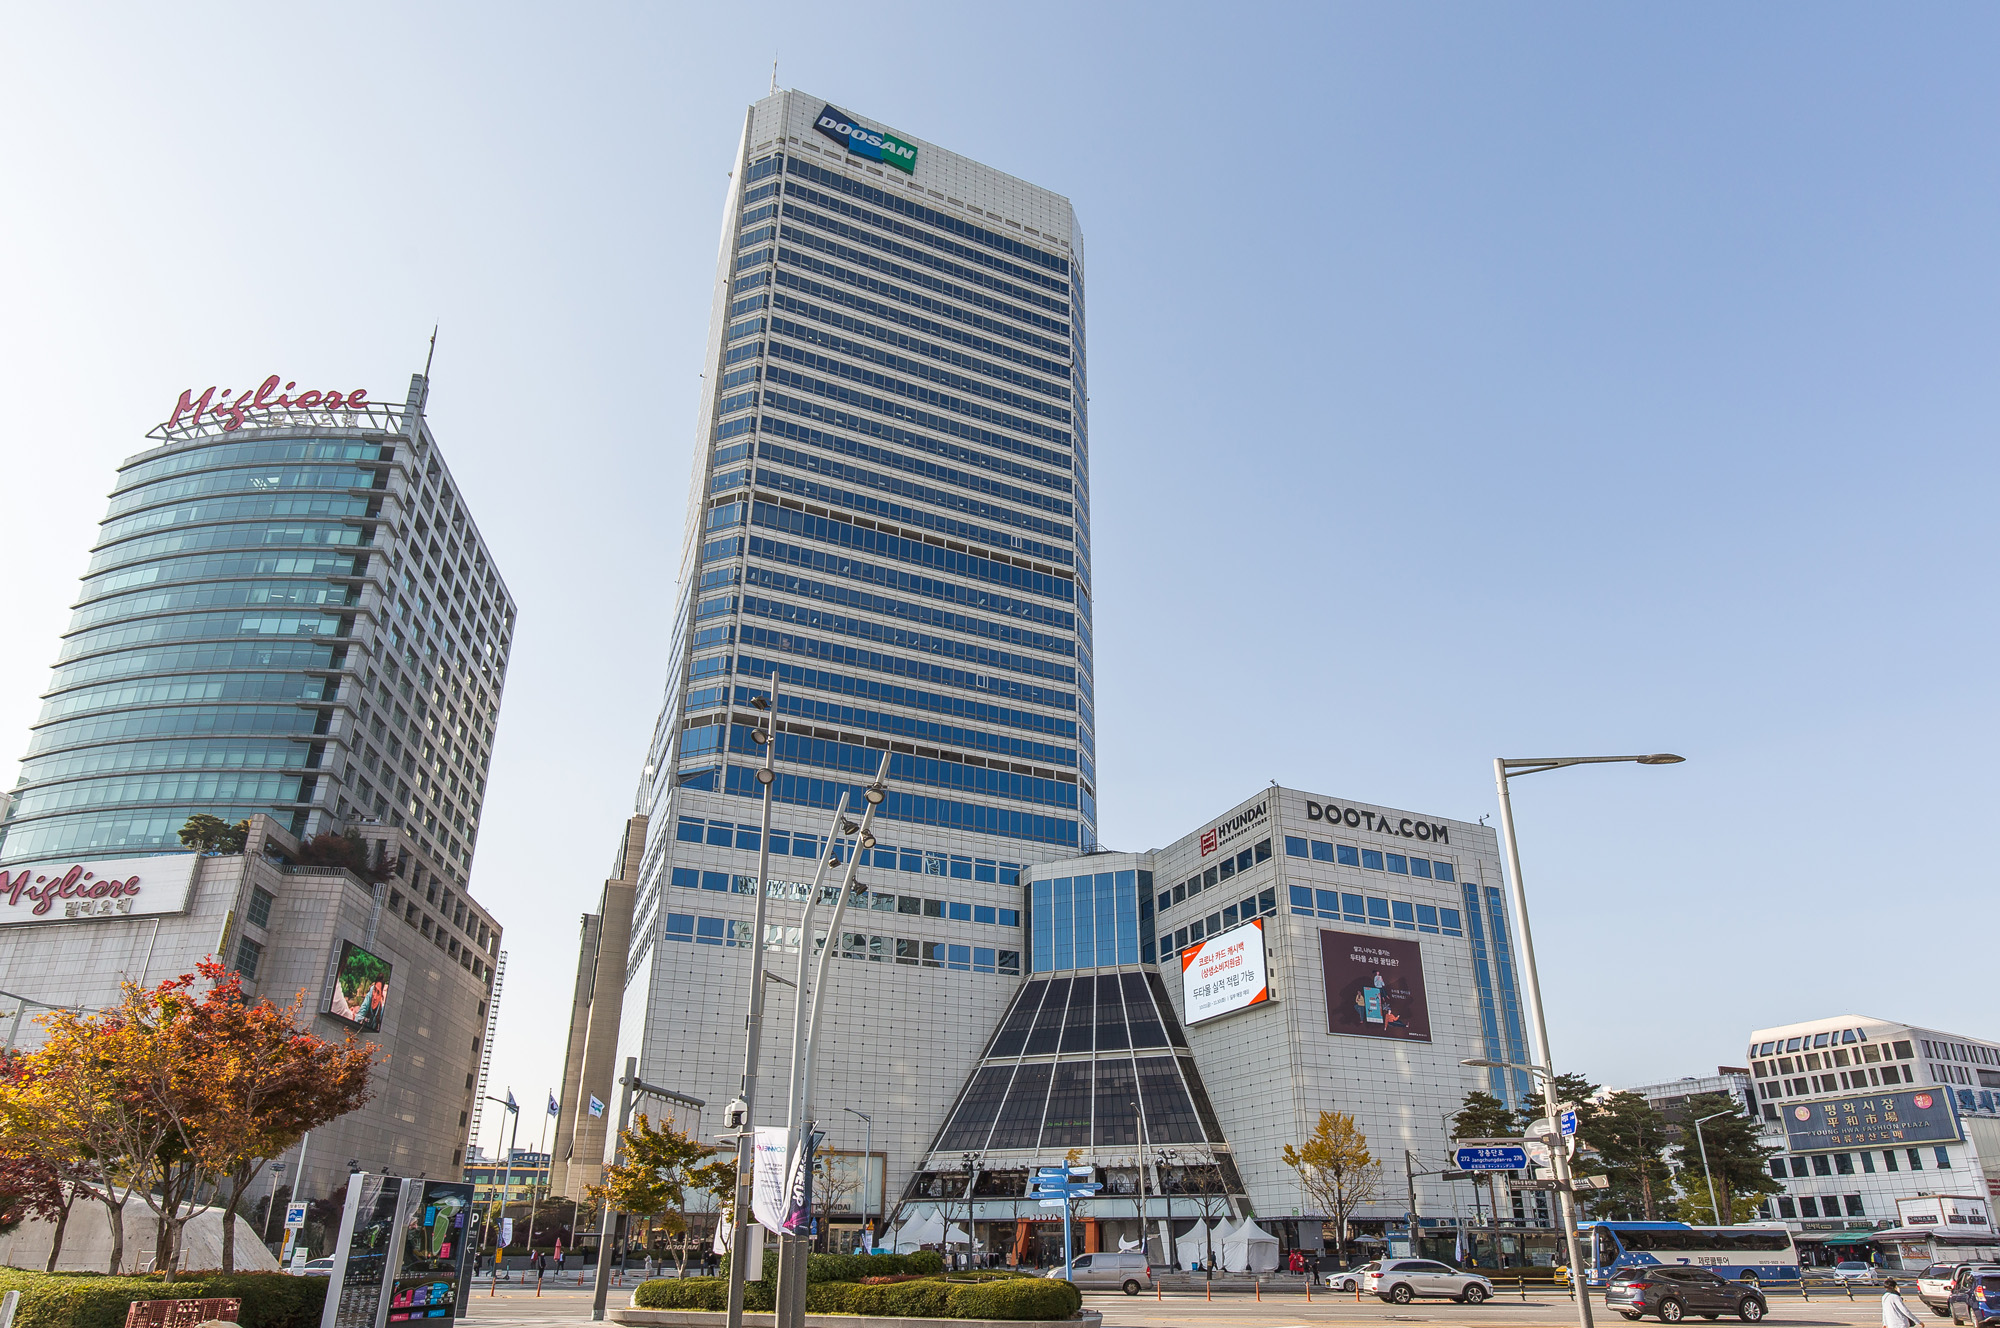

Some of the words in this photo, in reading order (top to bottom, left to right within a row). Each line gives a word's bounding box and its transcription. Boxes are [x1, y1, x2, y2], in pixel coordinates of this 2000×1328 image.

[818, 116, 914, 160] DOOSAN
[168, 375, 370, 431] Migliore
[1218, 801, 1267, 838] HYUNDAI
[1219, 826, 1251, 846] DEPARTMENT
[1251, 817, 1268, 830] STORE
[1307, 800, 1449, 844] DOOTA.COM
[0, 865, 141, 915] Migliore
[65, 897, 134, 917] 밀리오레
[1198, 953, 1214, 967] 코로나
[1215, 949, 1227, 961] 카드
[1227, 941, 1245, 956] 캐시백
[1368, 957, 1379, 965] 쇼핑
[1201, 955, 1243, 979] (상생소비지원금)
[1193, 984, 1211, 1000] 두타몰
[1212, 979, 1225, 994] 실적
[1226, 973, 1240, 988] 적립
[1241, 970, 1255, 983] 가능
[1823, 1098, 1895, 1116] 평화시장
[1827, 1111, 1899, 1128] 平和市場
[1862, 1123, 1900, 1132] FASHION
[1901, 1120, 1931, 1128] PLAZA
[1831, 1130, 1904, 1144] 의류생산도매
[1478, 1149, 1504, 1157] 장충단로
[470, 1212, 479, 1228] P
